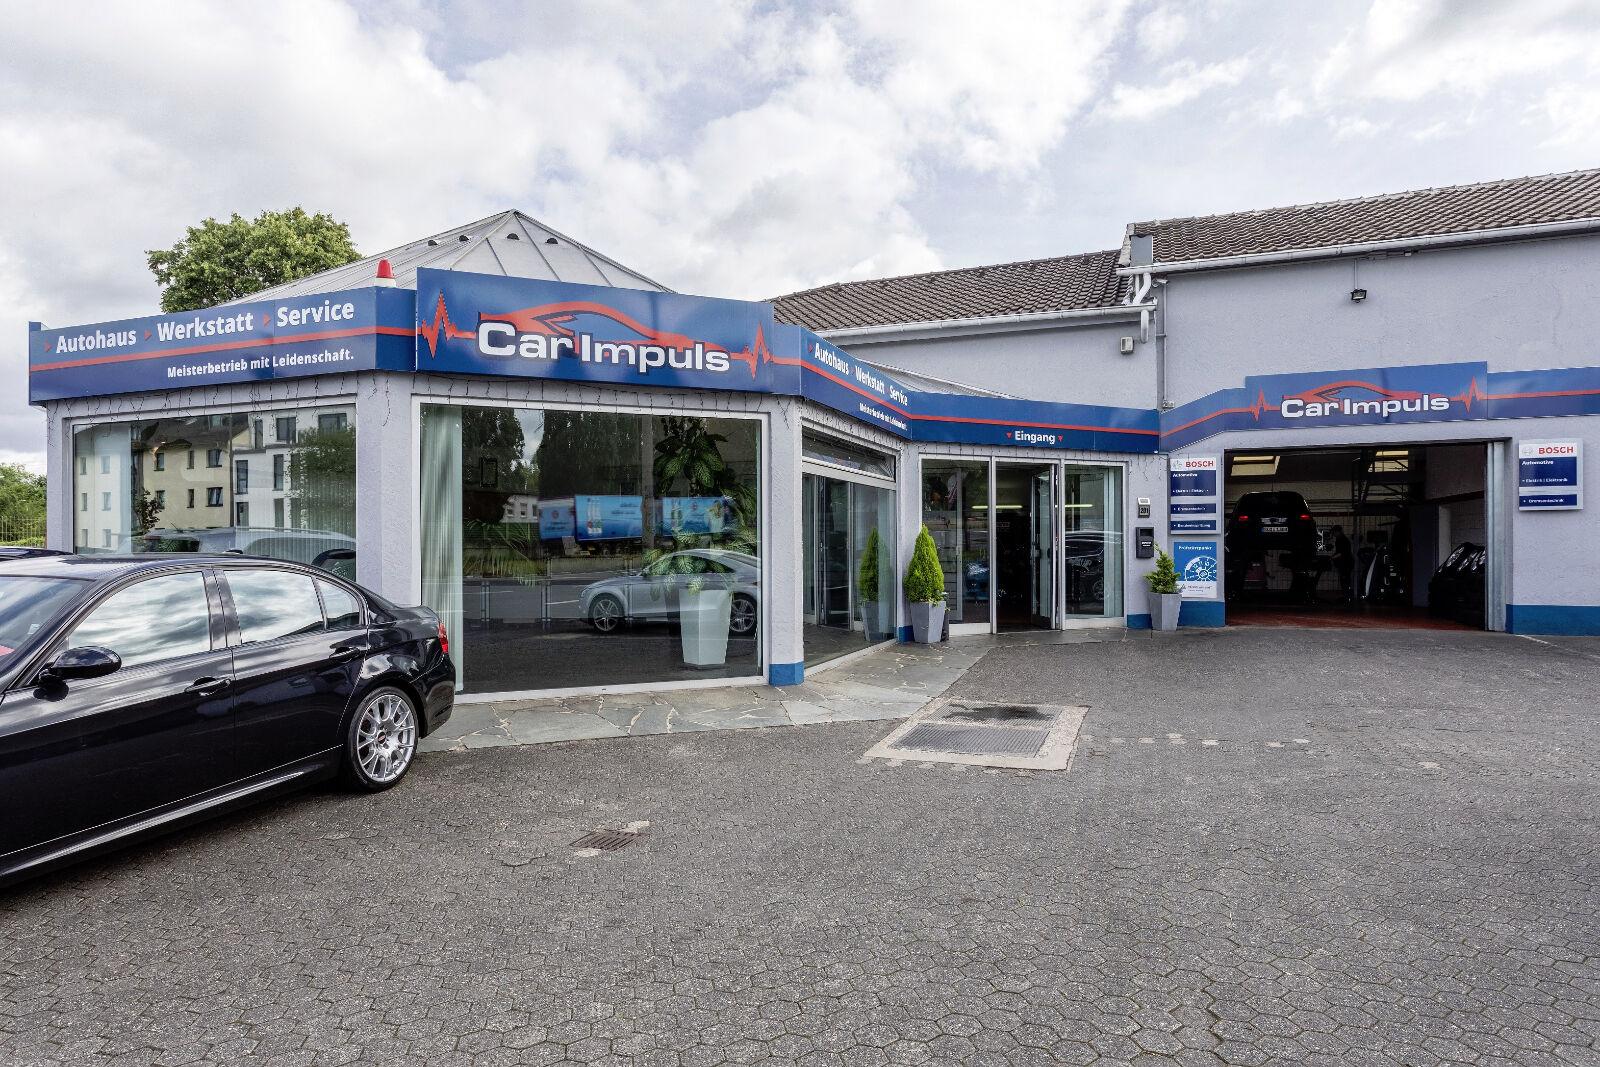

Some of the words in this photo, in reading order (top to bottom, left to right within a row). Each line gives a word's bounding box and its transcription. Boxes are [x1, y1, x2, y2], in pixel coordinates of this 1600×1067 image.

[56, 328, 137, 354] Autohaus
[157, 312, 254, 342] Werkstatt
[277, 300, 355, 328] Service
[167, 358, 248, 378] Meisterbetrieb
[250, 356, 270, 369] mit
[272, 348, 355, 369] Leidenschaft.
[814, 342, 849, 375] Autohaus
[855, 365, 885, 395] Werkstatt
[890, 385, 908, 406] Service
[1014, 430, 1056, 445] Eingang
[1538, 446, 1574, 455] BOSCH
[1185, 460, 1214, 468] BOSCH
